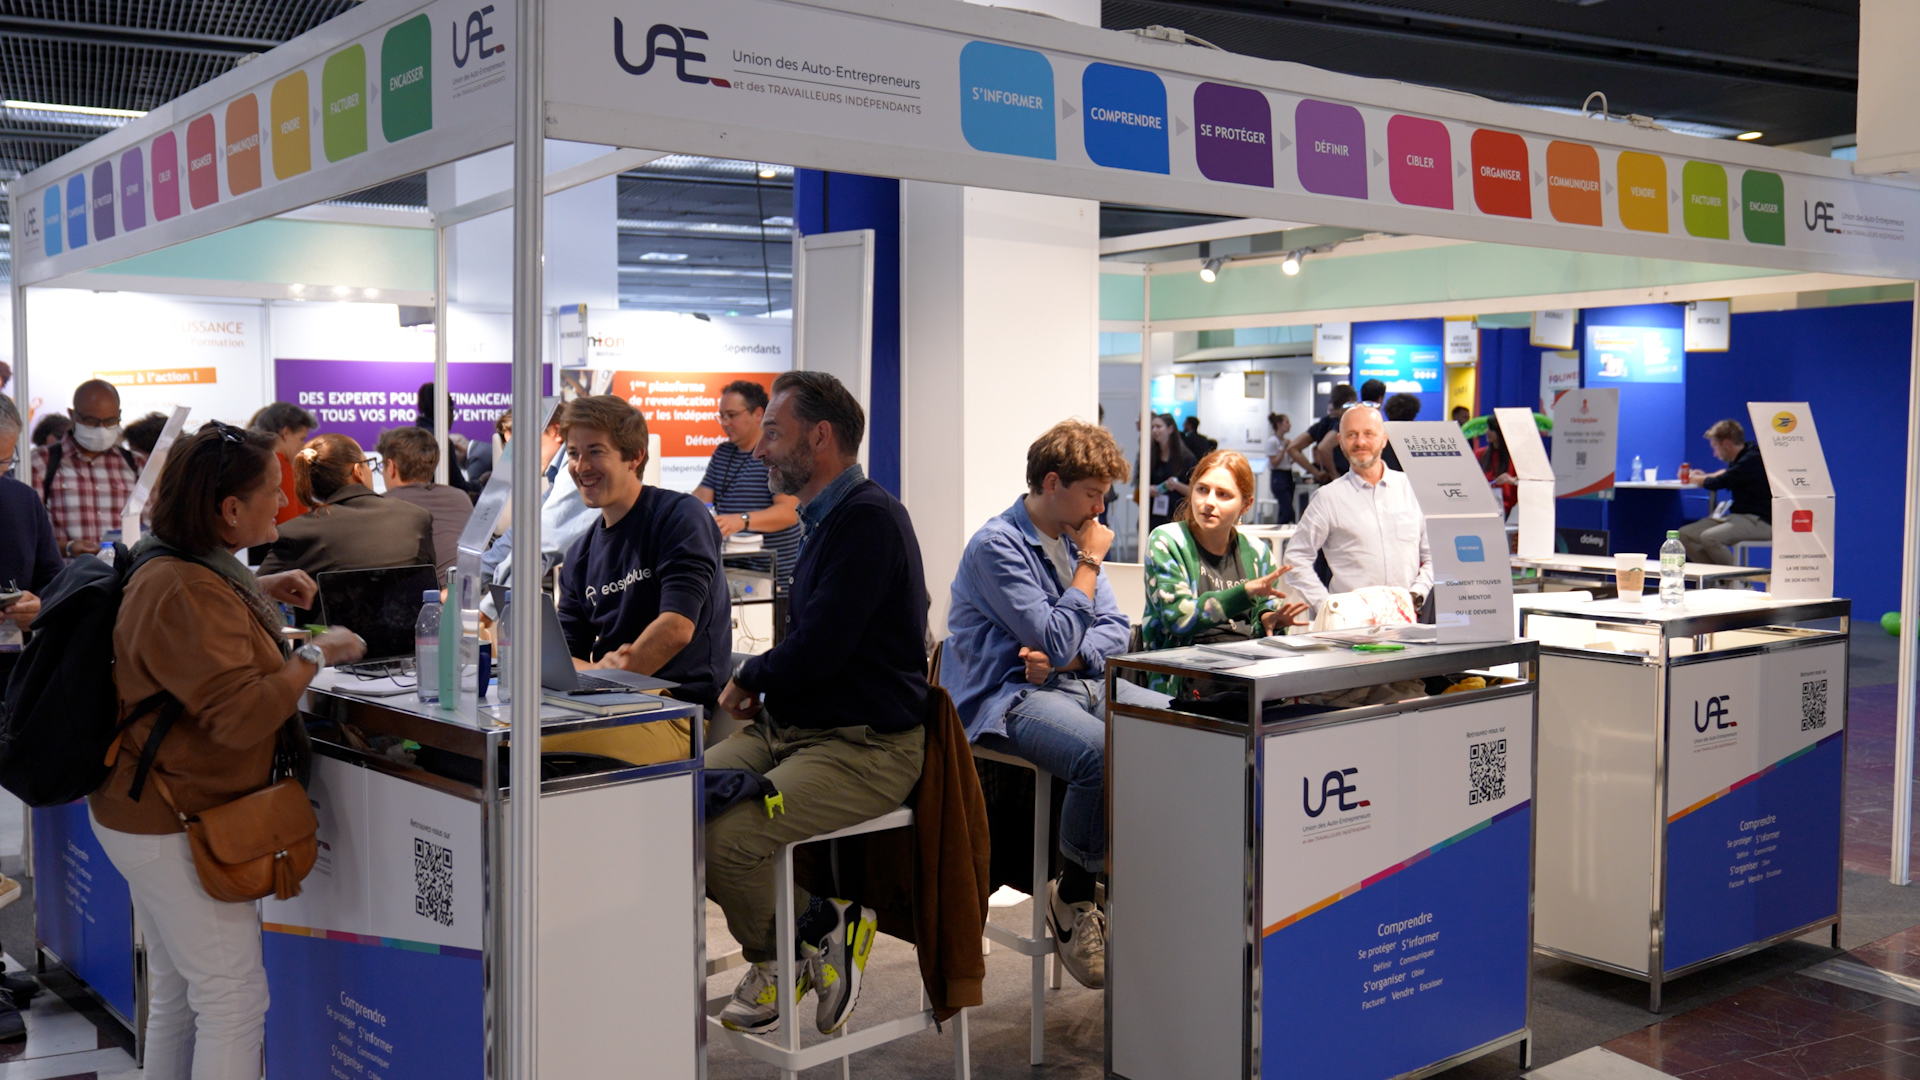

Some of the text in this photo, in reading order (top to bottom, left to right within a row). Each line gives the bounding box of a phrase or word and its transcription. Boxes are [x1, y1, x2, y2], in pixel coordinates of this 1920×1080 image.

[453, 5, 505, 68] UAE
[614, 16, 732, 84] UAE
[390, 66, 424, 92] ENCAISSER
[732, 49, 921, 90] Union des Auto-Entrepreneurs
[330, 92, 360, 115] FACTURER
[733, 80, 922, 115] et des TRAVAILLEURS INDÉPENDANTS
[280, 117, 300, 134] VENDRE
[1090, 106, 1162, 130] COMPRENDRE
[1200, 124, 1266, 144] SE PROTÉGER
[227, 134, 260, 156] COMMUNIQUER
[1314, 139, 1350, 156] DÉFINIR
[190, 153, 212, 171] ORGANISER
[1406, 154, 1434, 169] CIBLER
[1480, 166, 1522, 181] ORGANISER
[1548, 175, 1600, 192] COMMUNIQUER
[1630, 186, 1656, 198] VENDRE
[1691, 194, 1722, 207] FACTURER
[1749, 201, 1779, 214] ENCAISSER
[1804, 200, 1842, 234] UAE
[1842, 212, 1905, 227] Union des Auto-Entrepreneurs
[648, 380, 706, 394] plateforme
[298, 391, 324, 405] DES
[328, 392, 387, 406] EXPERTS
[390, 392, 418, 406] POU
[629, 395, 642, 407] de
[645, 395, 715, 407] revendication
[320, 408, 356, 422] TOUS
[359, 408, 386, 422] VOS
[390, 408, 417, 422] PRO
[656, 410, 672, 421] les
[600, 566, 652, 596] easyblue
[1473, 608, 1497, 616] DEVENIR
[1694, 694, 1738, 733] UAE
[1466, 728, 1498, 739] Retrouvez-nous
[1303, 767, 1370, 818] UAE
[410, 818, 442, 839] Retrouvez-nous
[1302, 812, 1371, 832] Union des Auto-Entrepreneurs
[1740, 814, 1776, 832] Comprendre
[1734, 834, 1753, 848] protéger
[1378, 911, 1433, 937] Comprendre
[1358, 948, 1368, 960] Se
[1368, 940, 1397, 958] protéger
[1373, 948, 1435, 973] Définir Communiquer
[1411, 967, 1426, 978] Cibler
[1362, 978, 1444, 1010] Facturer Vendre Encaisser
[326, 1004, 334, 1016] Se
[334, 1011, 356, 1030] protéger
[340, 991, 386, 1027] Comprendre
